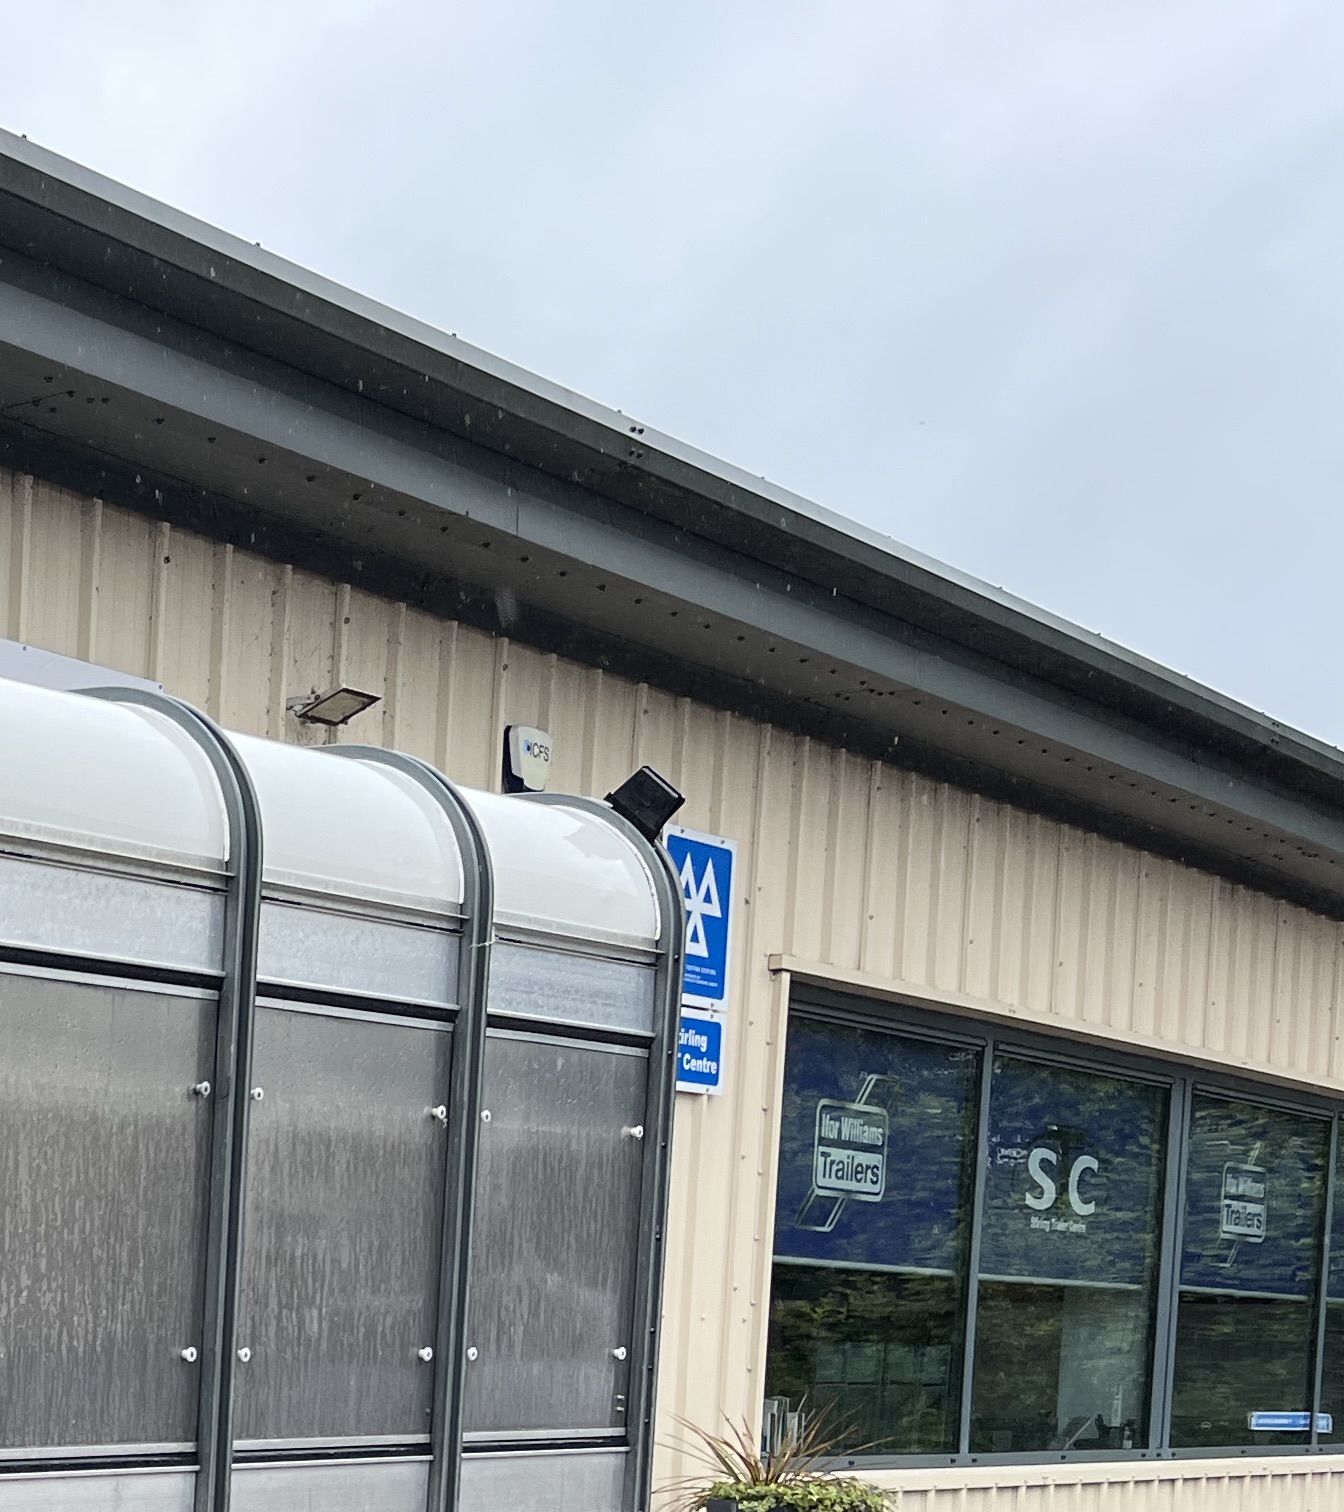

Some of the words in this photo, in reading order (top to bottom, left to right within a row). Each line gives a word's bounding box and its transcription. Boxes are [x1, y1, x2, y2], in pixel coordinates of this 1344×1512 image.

[683, 1053, 718, 1075] Centre
[821, 1113, 840, 1139] Ifor
[841, 1116, 884, 1146] Williams
[820, 1151, 879, 1185] Trailers
[1225, 1204, 1263, 1230] Trailers
